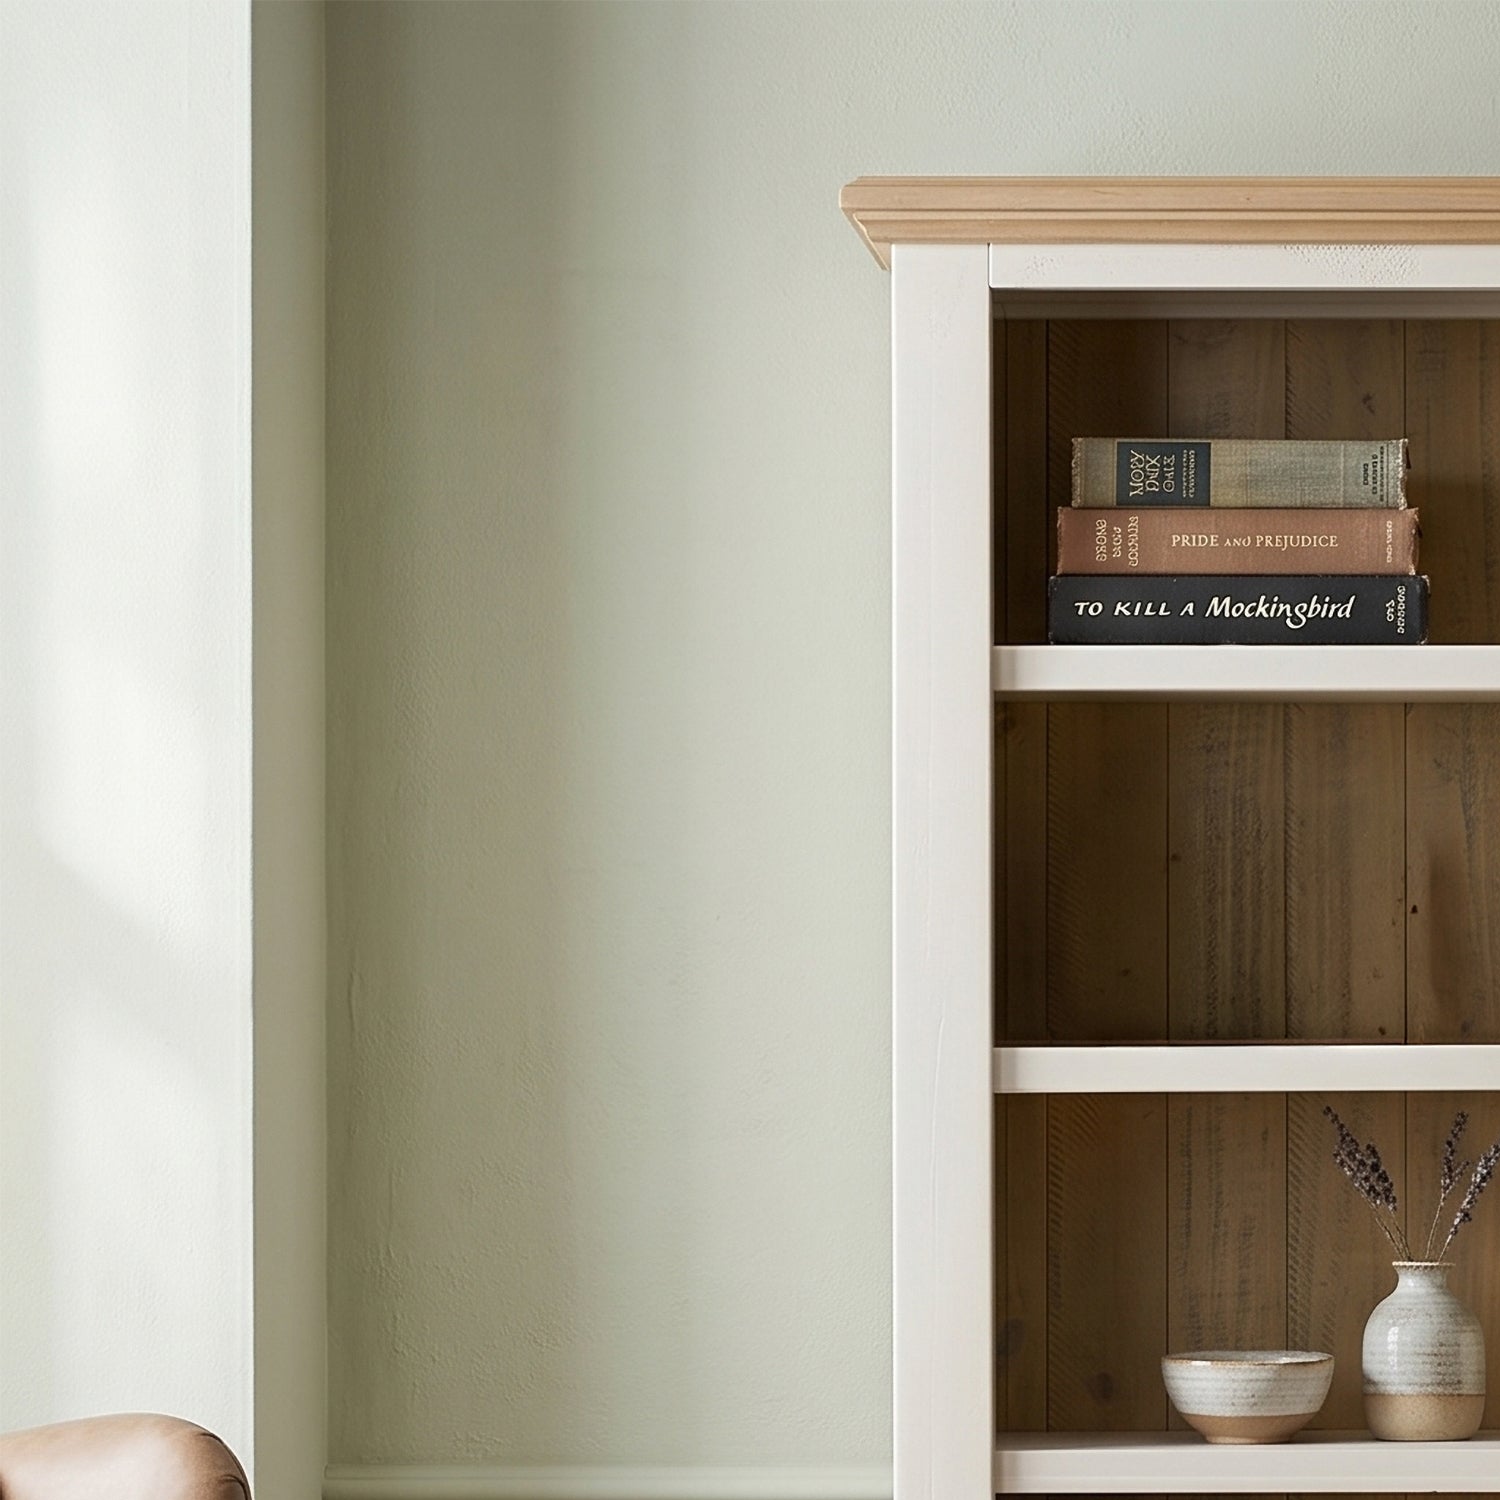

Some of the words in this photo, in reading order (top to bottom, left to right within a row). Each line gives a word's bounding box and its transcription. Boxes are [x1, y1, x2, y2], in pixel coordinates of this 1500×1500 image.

[1171, 534, 1219, 547] PRIDE
[1256, 535, 1339, 551] PREJUDICE
[1074, 602, 1103, 616] TO
[1114, 601, 1171, 616] KILL
[1180, 602, 1194, 616] A
[1205, 595, 1356, 629] Mockingbird
